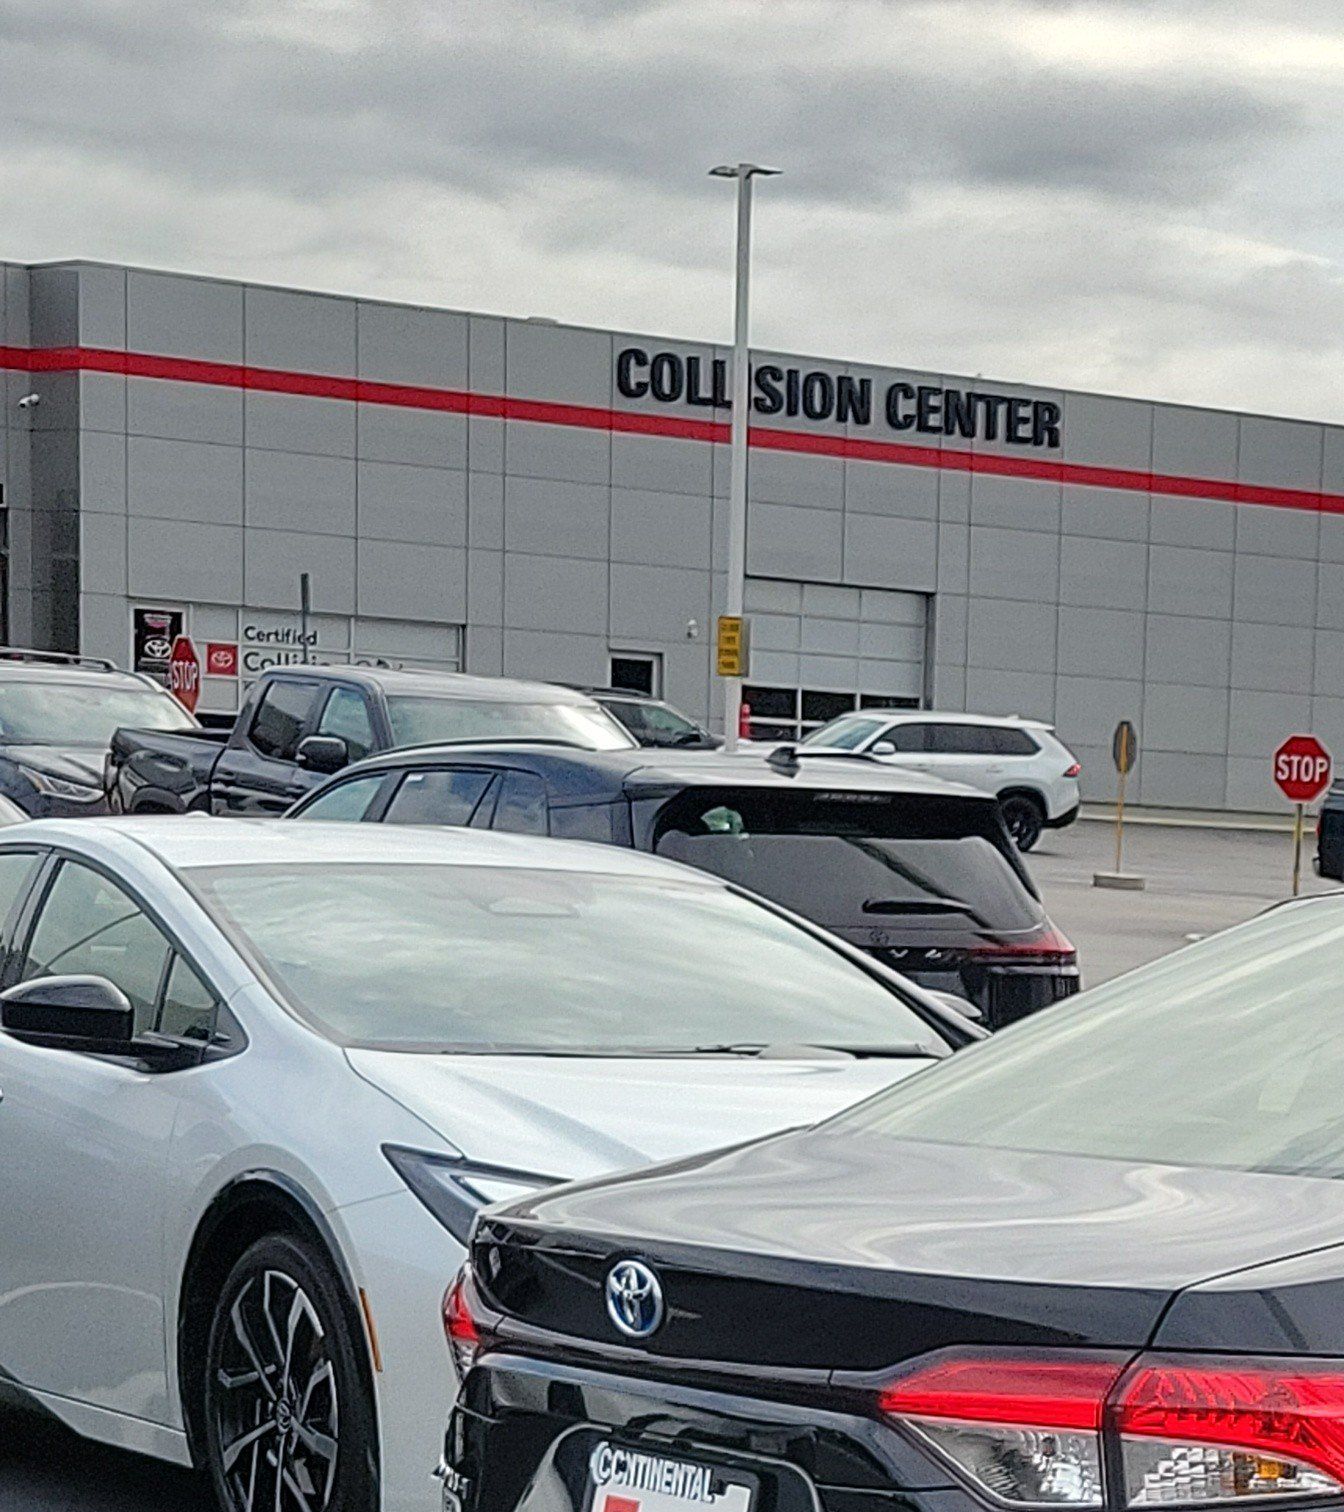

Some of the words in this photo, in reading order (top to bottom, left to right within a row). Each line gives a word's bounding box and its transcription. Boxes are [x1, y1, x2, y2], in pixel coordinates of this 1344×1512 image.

[616, 347, 872, 425] COLLSION
[886, 382, 1062, 449] CENTER
[172, 660, 198, 690] STOP
[1276, 754, 1329, 784] STOP
